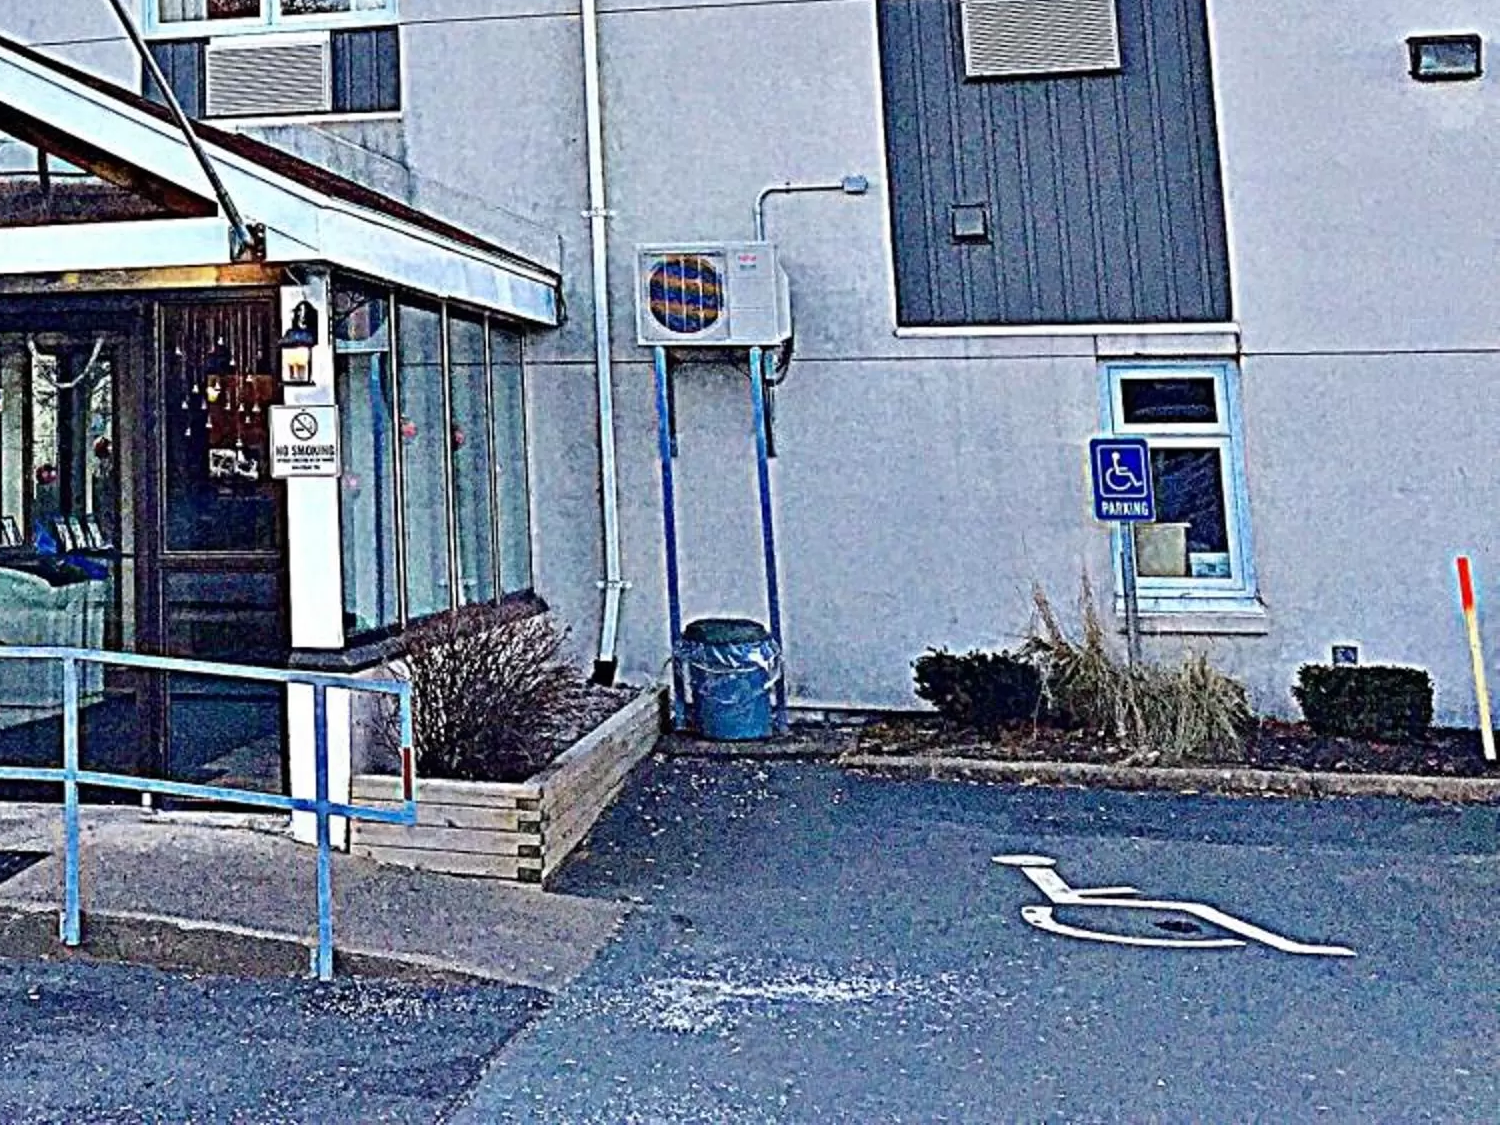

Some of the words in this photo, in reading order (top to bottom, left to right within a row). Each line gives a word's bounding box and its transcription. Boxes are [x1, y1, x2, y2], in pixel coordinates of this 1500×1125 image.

[275, 444, 288, 457] NO
[291, 444, 335, 456] SMOKING
[1101, 500, 1149, 516] PARKING
